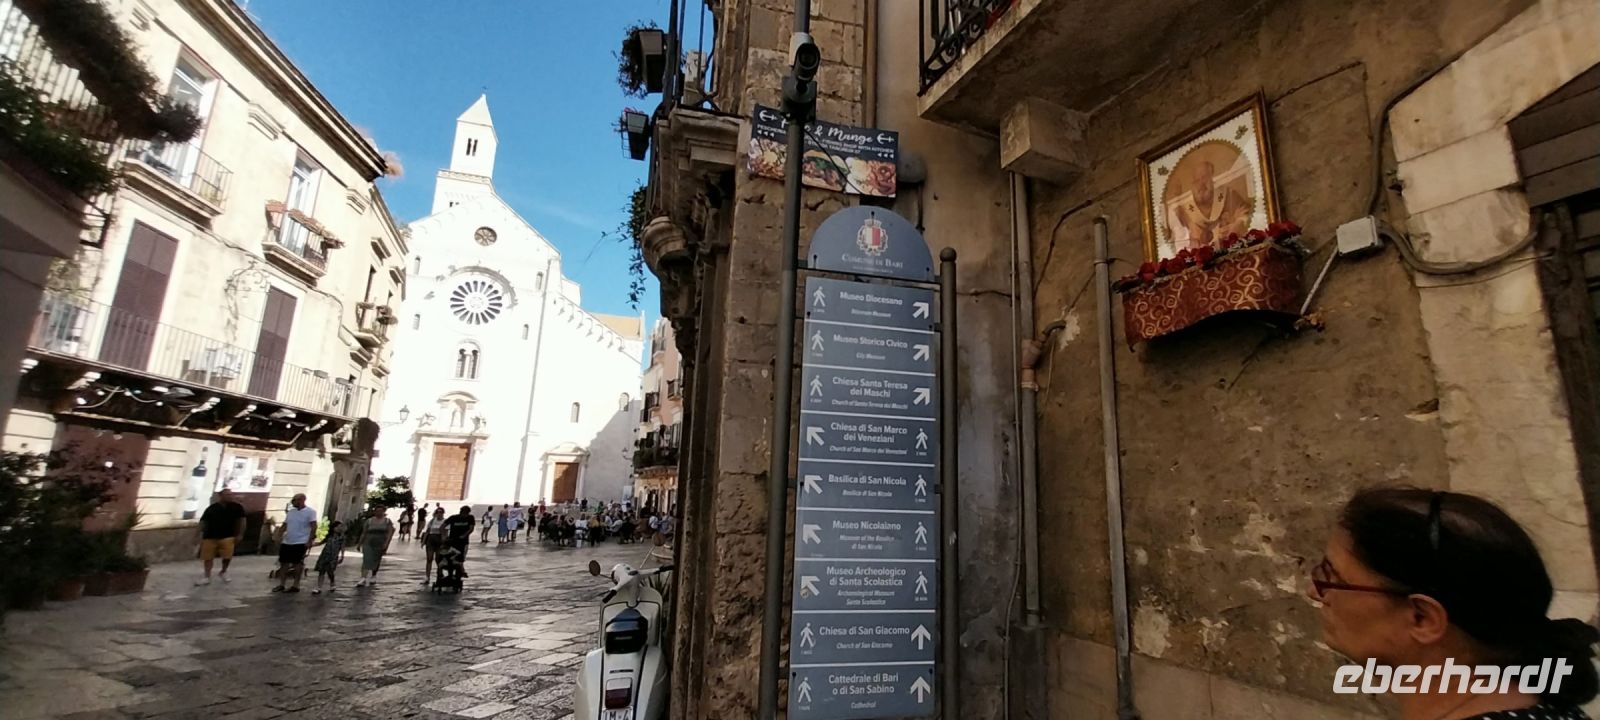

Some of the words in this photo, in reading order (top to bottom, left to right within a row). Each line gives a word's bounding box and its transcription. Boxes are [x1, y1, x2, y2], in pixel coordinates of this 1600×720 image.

[814, 125, 823, 137] &
[828, 126, 872, 145] Mange
[840, 291, 864, 302] Museo
[866, 294, 903, 305] Diocesano
[833, 334, 858, 344] Museo
[860, 336, 885, 347] Storico
[886, 338, 908, 349] Civico
[832, 376, 859, 386] Chiesa
[860, 378, 882, 388] Santa
[883, 380, 908, 389] Teresa
[850, 387, 862, 396] dei
[864, 388, 891, 398] Maschi
[831, 422, 858, 432] Chiesa
[858, 422, 867, 432] di
[868, 424, 882, 433] San
[884, 425, 908, 434] Marco
[843, 432, 857, 441] dei
[857, 433, 895, 443] Veneziani
[828, 474, 858, 484] Basilica
[859, 475, 867, 484] di
[868, 475, 882, 485] San
[883, 476, 907, 486] Nicola
[832, 520, 859, 529] Museo
[861, 521, 901, 530] Nicolaiano
[826, 566, 853, 576] Museo
[855, 566, 906, 577] Archeologico
[829, 577, 837, 586] di
[839, 577, 862, 586] Santa
[863, 577, 903, 586] Scolastica
[819, 626, 847, 636] Chiesa
[849, 626, 857, 635] di
[858, 626, 874, 635] San
[875, 626, 910, 635] Giacomo
[828, 673, 871, 684] Cattedrale
[872, 673, 881, 683] di
[882, 672, 899, 682] Bari
[832, 687, 838, 695] o
[840, 686, 848, 695] di
[849, 685, 865, 695] San
[867, 684, 895, 694] Sabino
[850, 701, 876, 709] Cathedral
